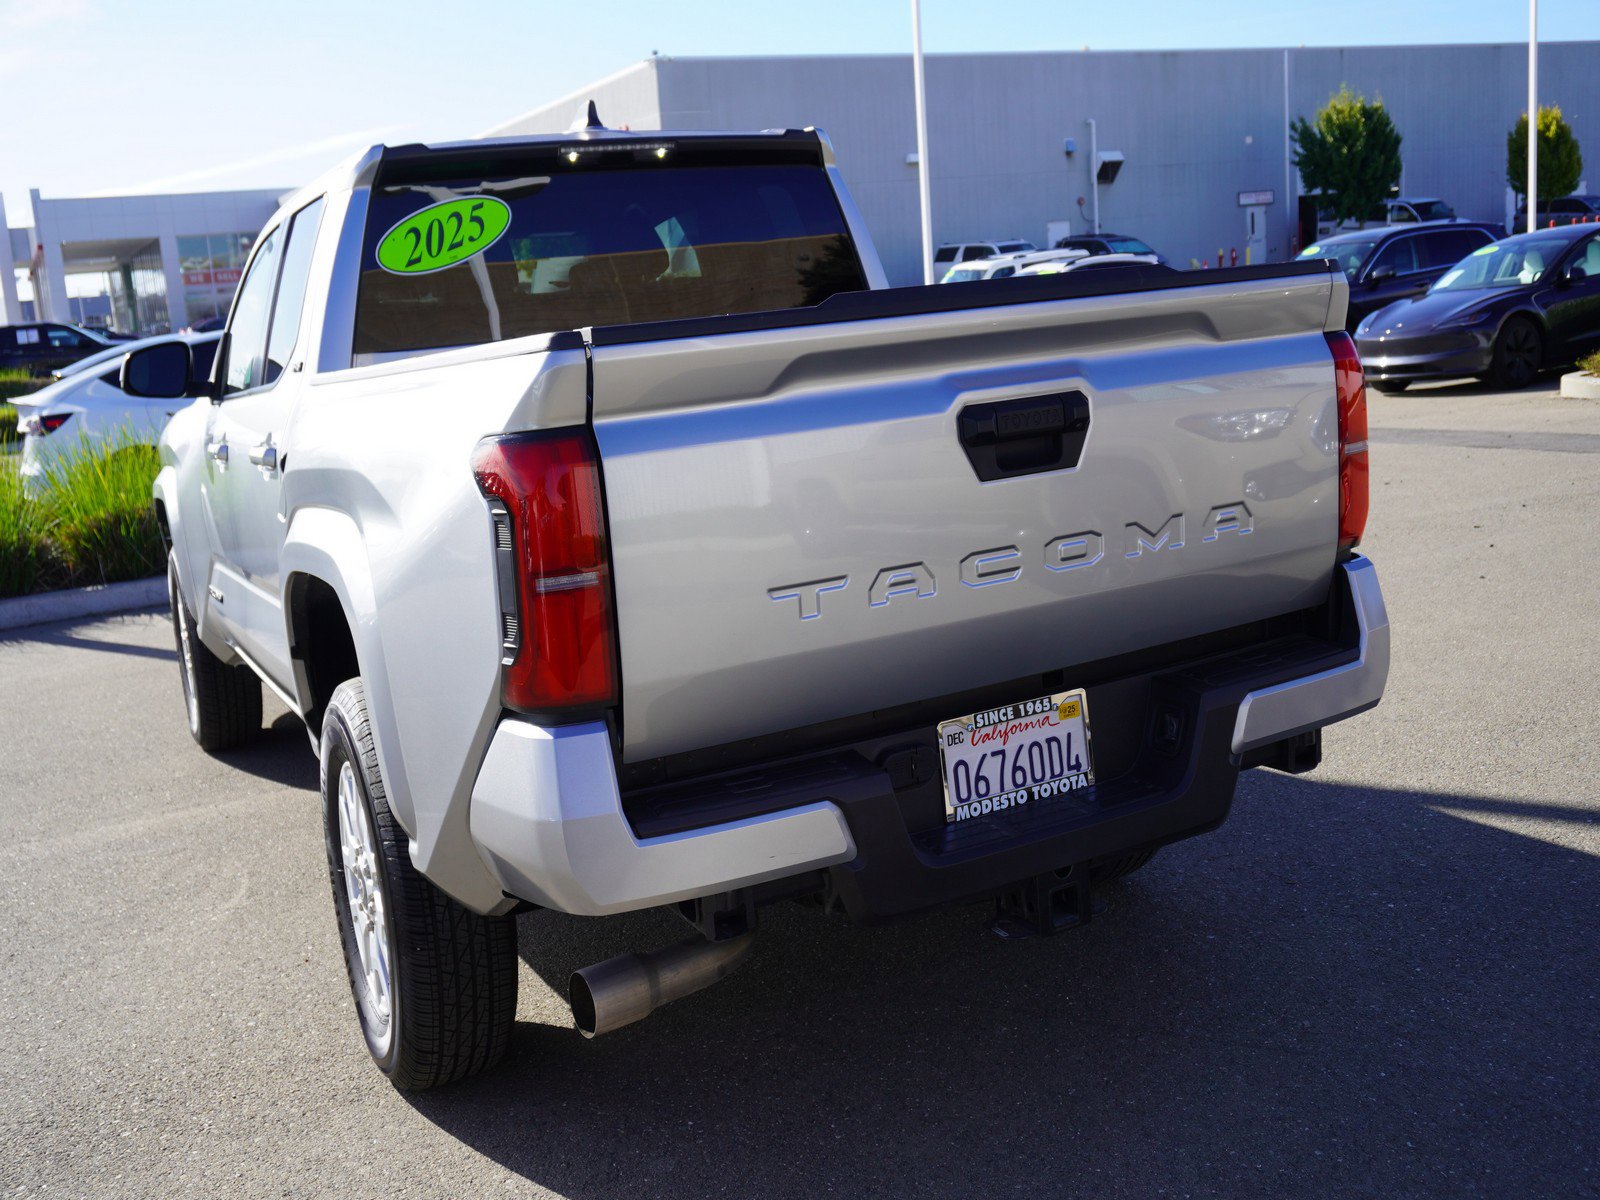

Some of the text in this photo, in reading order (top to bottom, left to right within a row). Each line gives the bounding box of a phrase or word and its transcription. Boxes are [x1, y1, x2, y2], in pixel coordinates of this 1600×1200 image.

[404, 202, 485, 268] 2025
[1001, 407, 1061, 428] TOYOTA
[767, 501, 1255, 621] TACOMA
[976, 708, 1015, 727] SINCE
[1019, 698, 1051, 717] 1965
[1067, 704, 1076, 714] 25
[947, 731, 965, 747] DEC
[971, 715, 1060, 746] California
[953, 732, 1082, 804] 06760D4
[956, 774, 1088, 821] MODESTO TOYOTA
